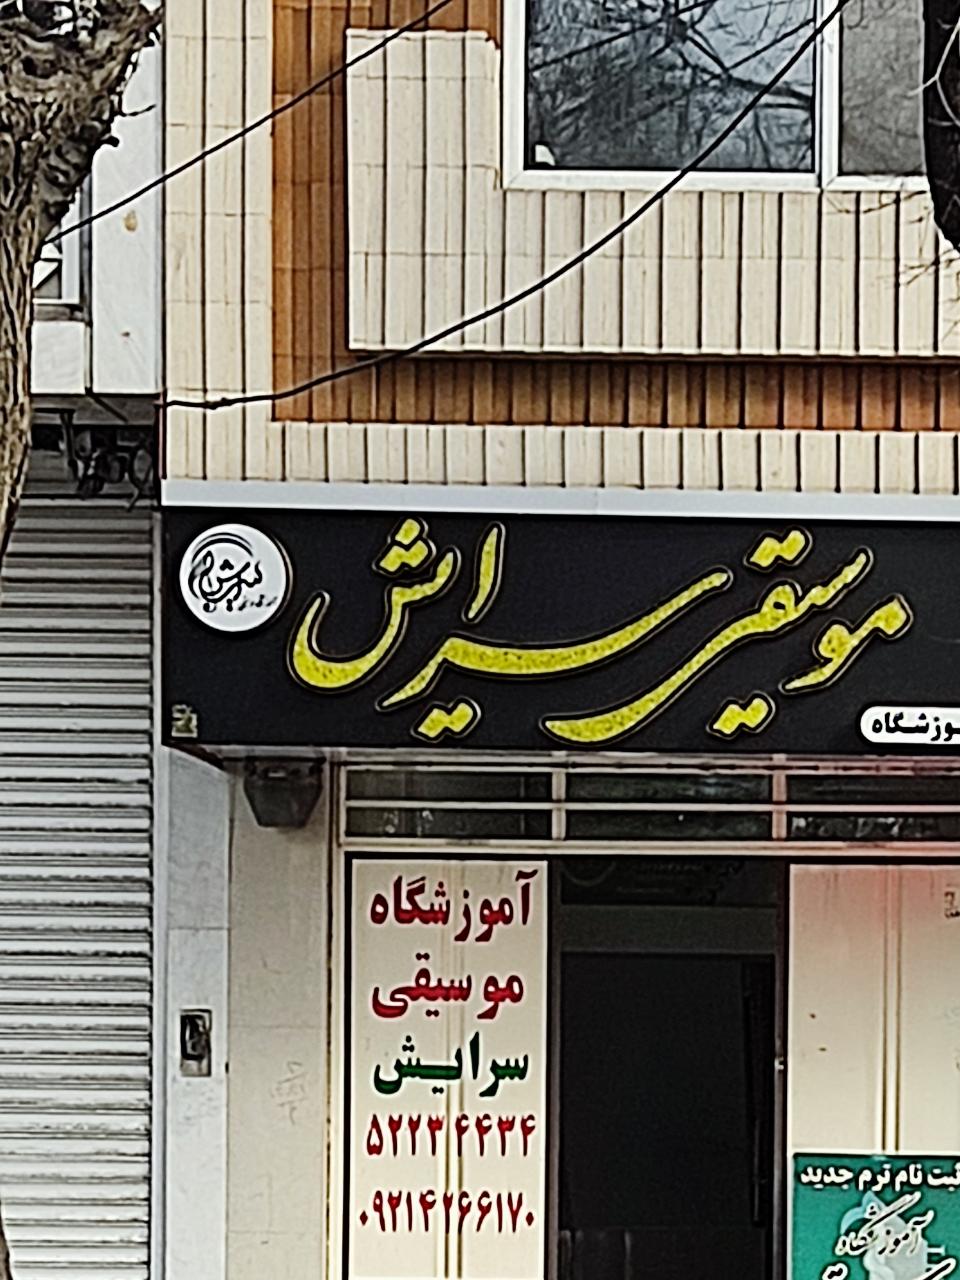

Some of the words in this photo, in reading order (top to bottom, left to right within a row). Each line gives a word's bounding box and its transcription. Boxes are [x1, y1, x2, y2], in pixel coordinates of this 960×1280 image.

[288, 517, 733, 740] سرایش
[541, 527, 912, 744] موسیقی
[370, 869, 539, 943] آموزشگاه
[372, 951, 525, 1020] موسیقی
[373, 1030, 529, 1097] سرایش
[366, 1113, 536, 1157] ۵۲۲۳۴۴۳۴
[800, 1166, 854, 1190] جدید
[858, 1163, 891, 1193] ترم
[895, 1163, 923, 1193] نام
[835, 1191, 935, 1256] آموزشگاه
